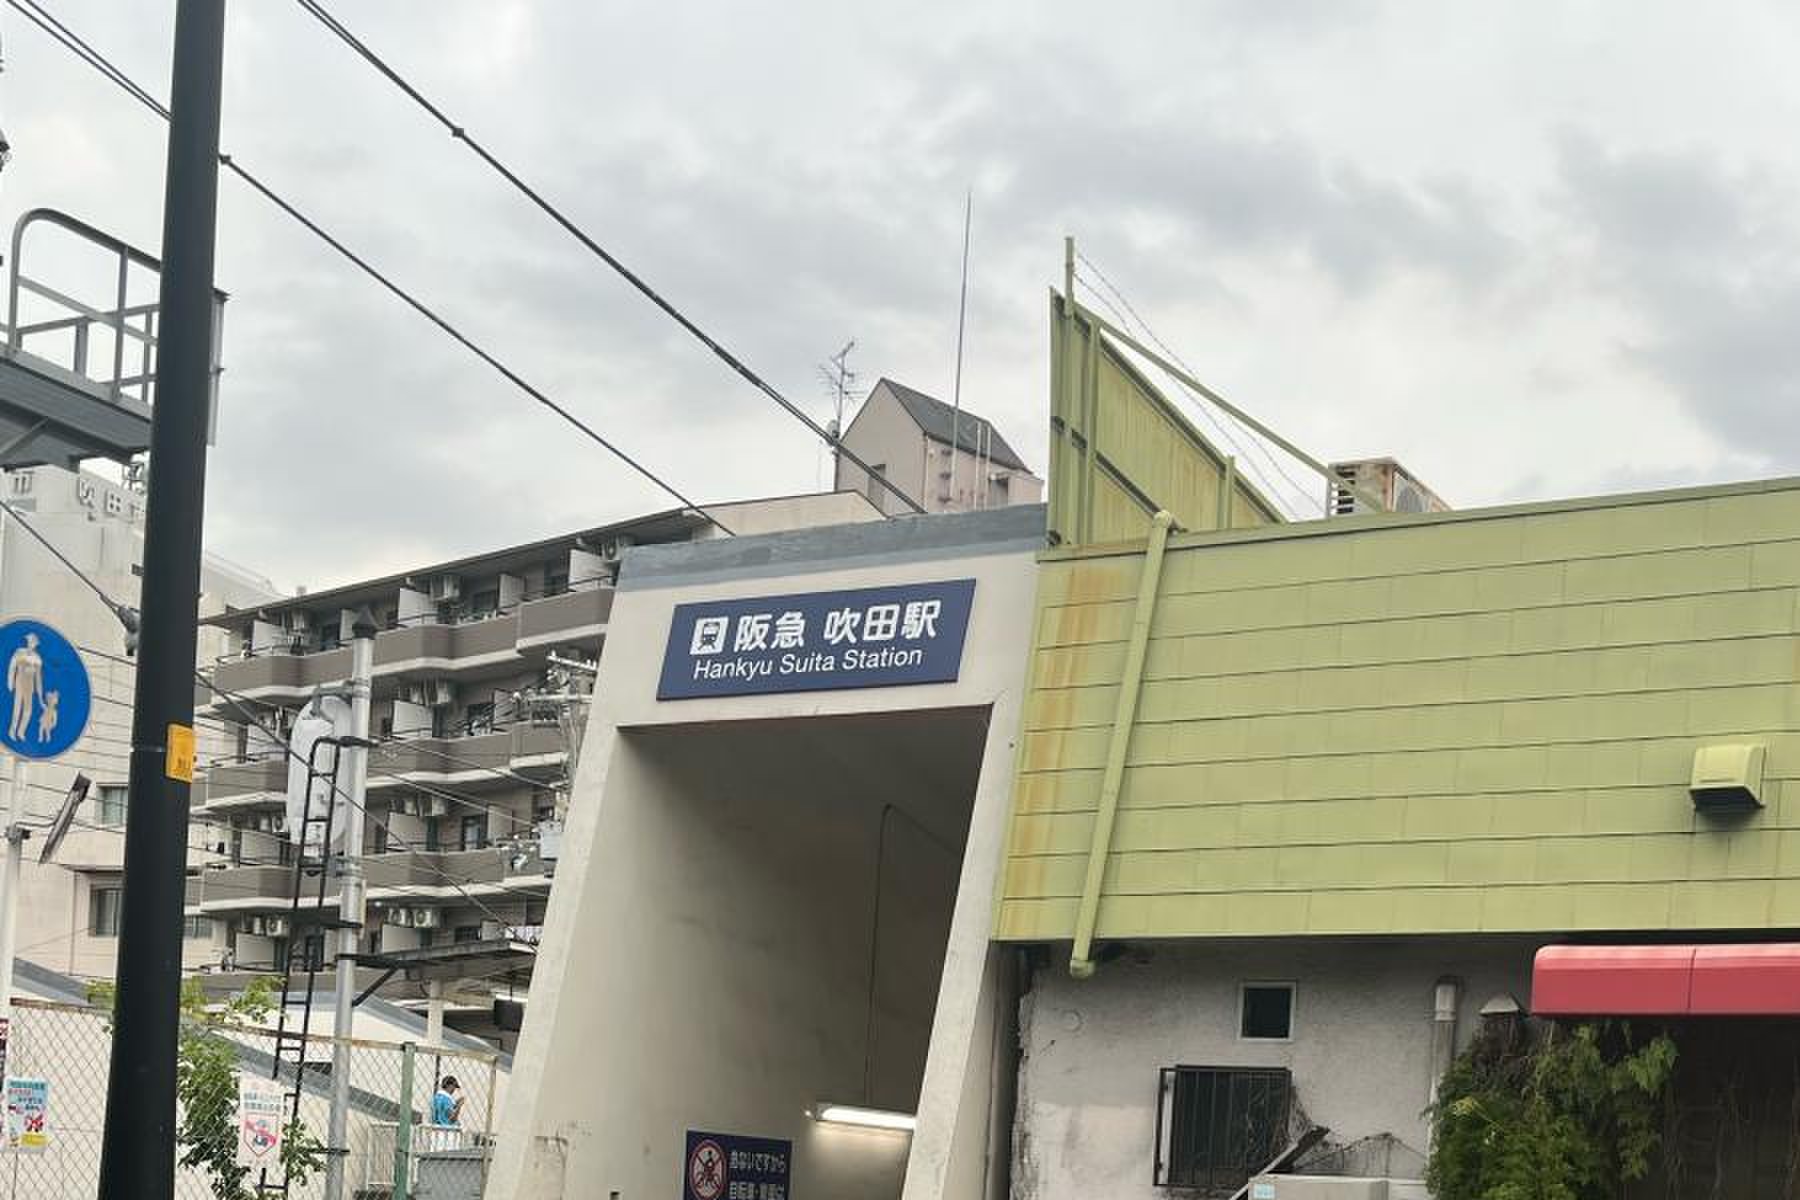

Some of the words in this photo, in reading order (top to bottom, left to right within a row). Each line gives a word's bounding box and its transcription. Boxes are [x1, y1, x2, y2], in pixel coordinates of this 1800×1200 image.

[733, 611, 806, 653] 阪急
[822, 599, 942, 646] 吹田駅
[692, 656, 773, 682] Hankyu
[779, 652, 835, 675] Suita
[842, 648, 923, 672] Station
